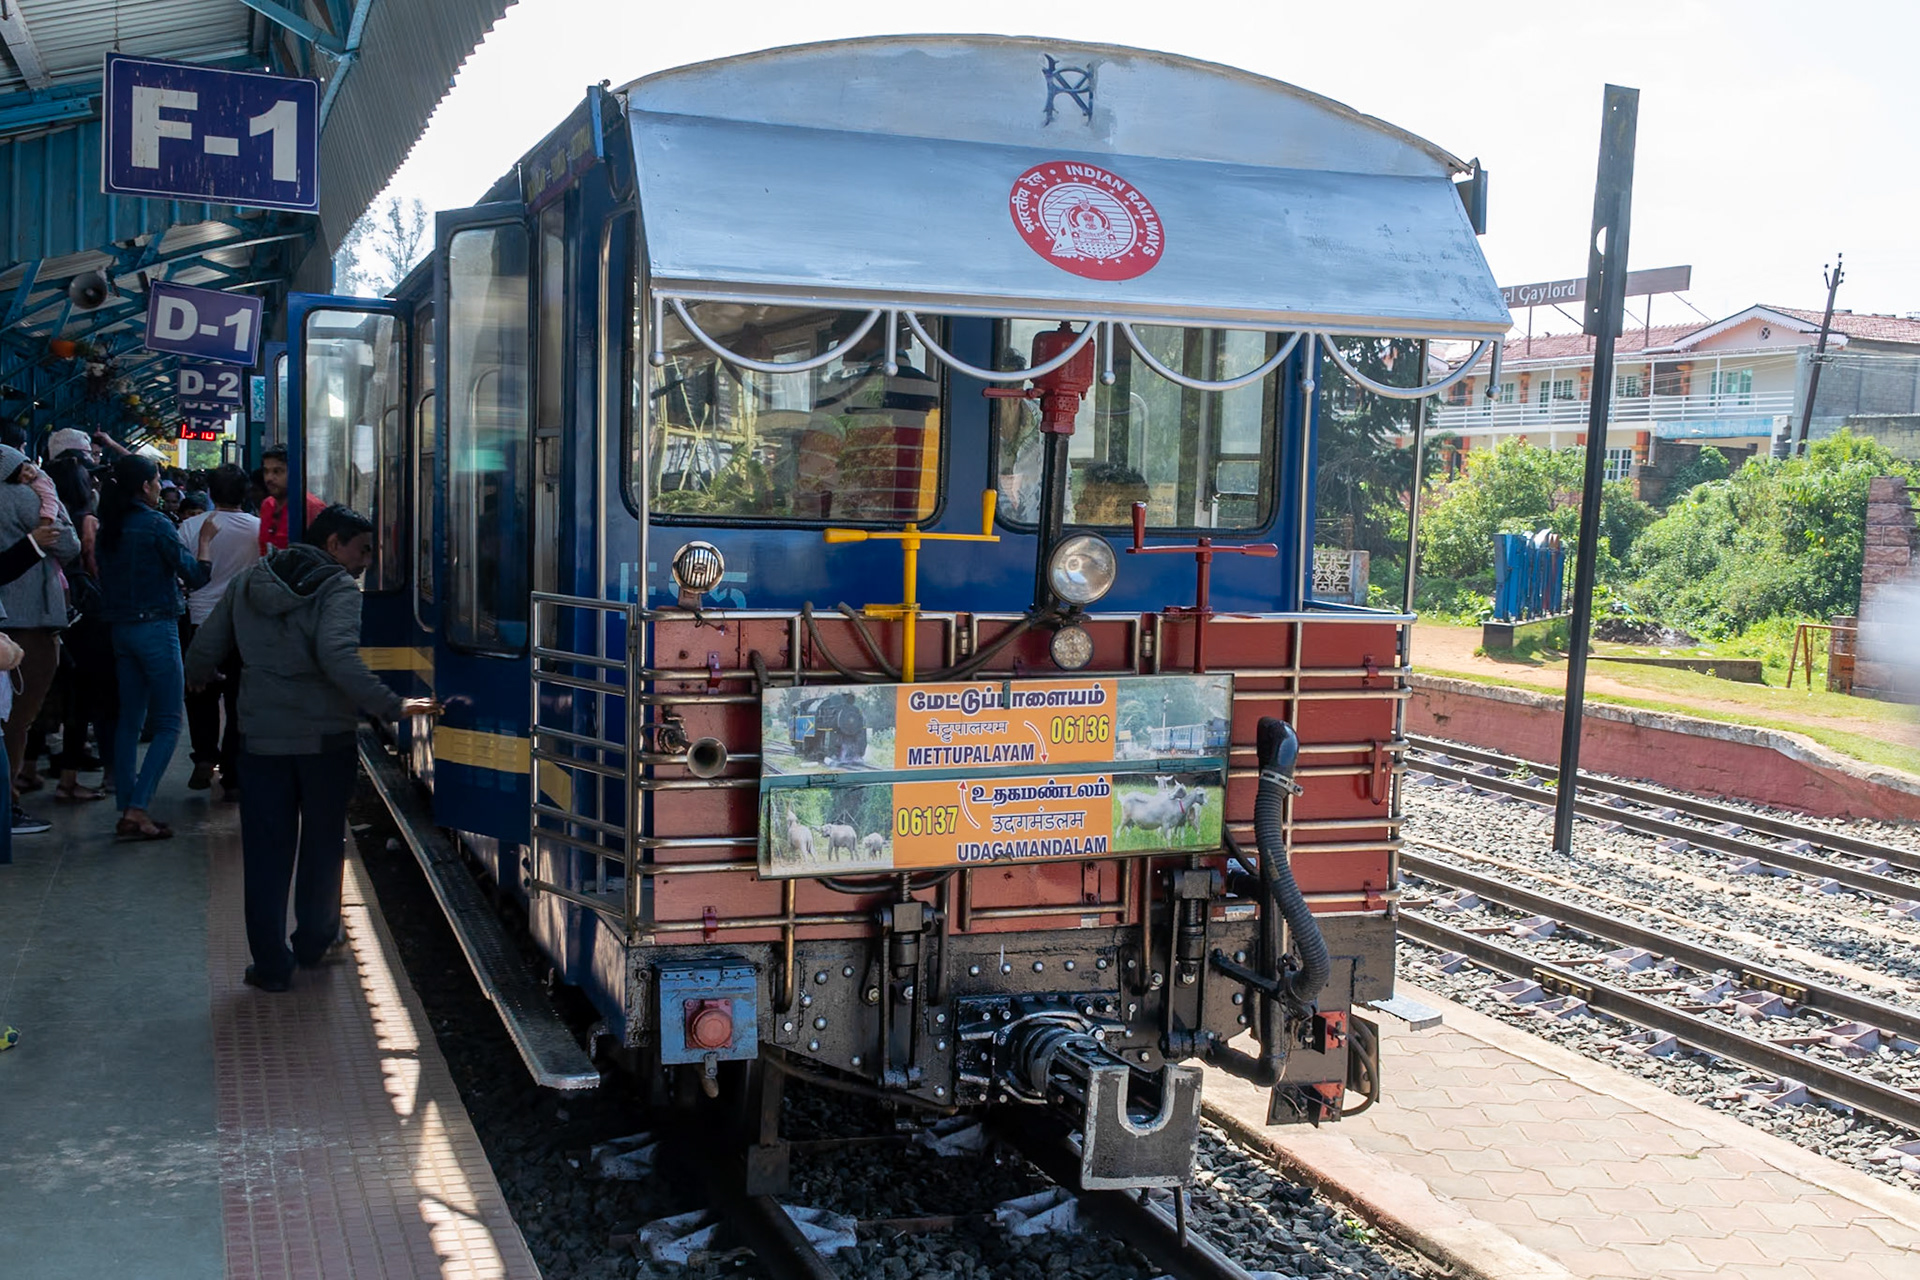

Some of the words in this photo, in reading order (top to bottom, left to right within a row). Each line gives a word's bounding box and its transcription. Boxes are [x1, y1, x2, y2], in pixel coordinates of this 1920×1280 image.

[131, 85, 299, 183] F-1
[1018, 171, 1046, 187] रेल
[1011, 186, 1035, 234] भारतीय
[1064, 164, 1126, 193] INDIAN
[1125, 190, 1160, 258] RAILWAYS
[1518, 279, 1577, 305] Gaylord
[153, 295, 253, 352] D-1
[179, 369, 239, 398] D-2
[1050, 715, 1110, 745] 06136
[907, 744, 1035, 766] METTUPALAYAM
[971, 777, 1110, 808] உதகமண்டலம்
[896, 805, 960, 838] 06137
[991, 806, 1086, 834] उदगमंडलम
[956, 836, 1108, 862] UDAGAMANDALAM
